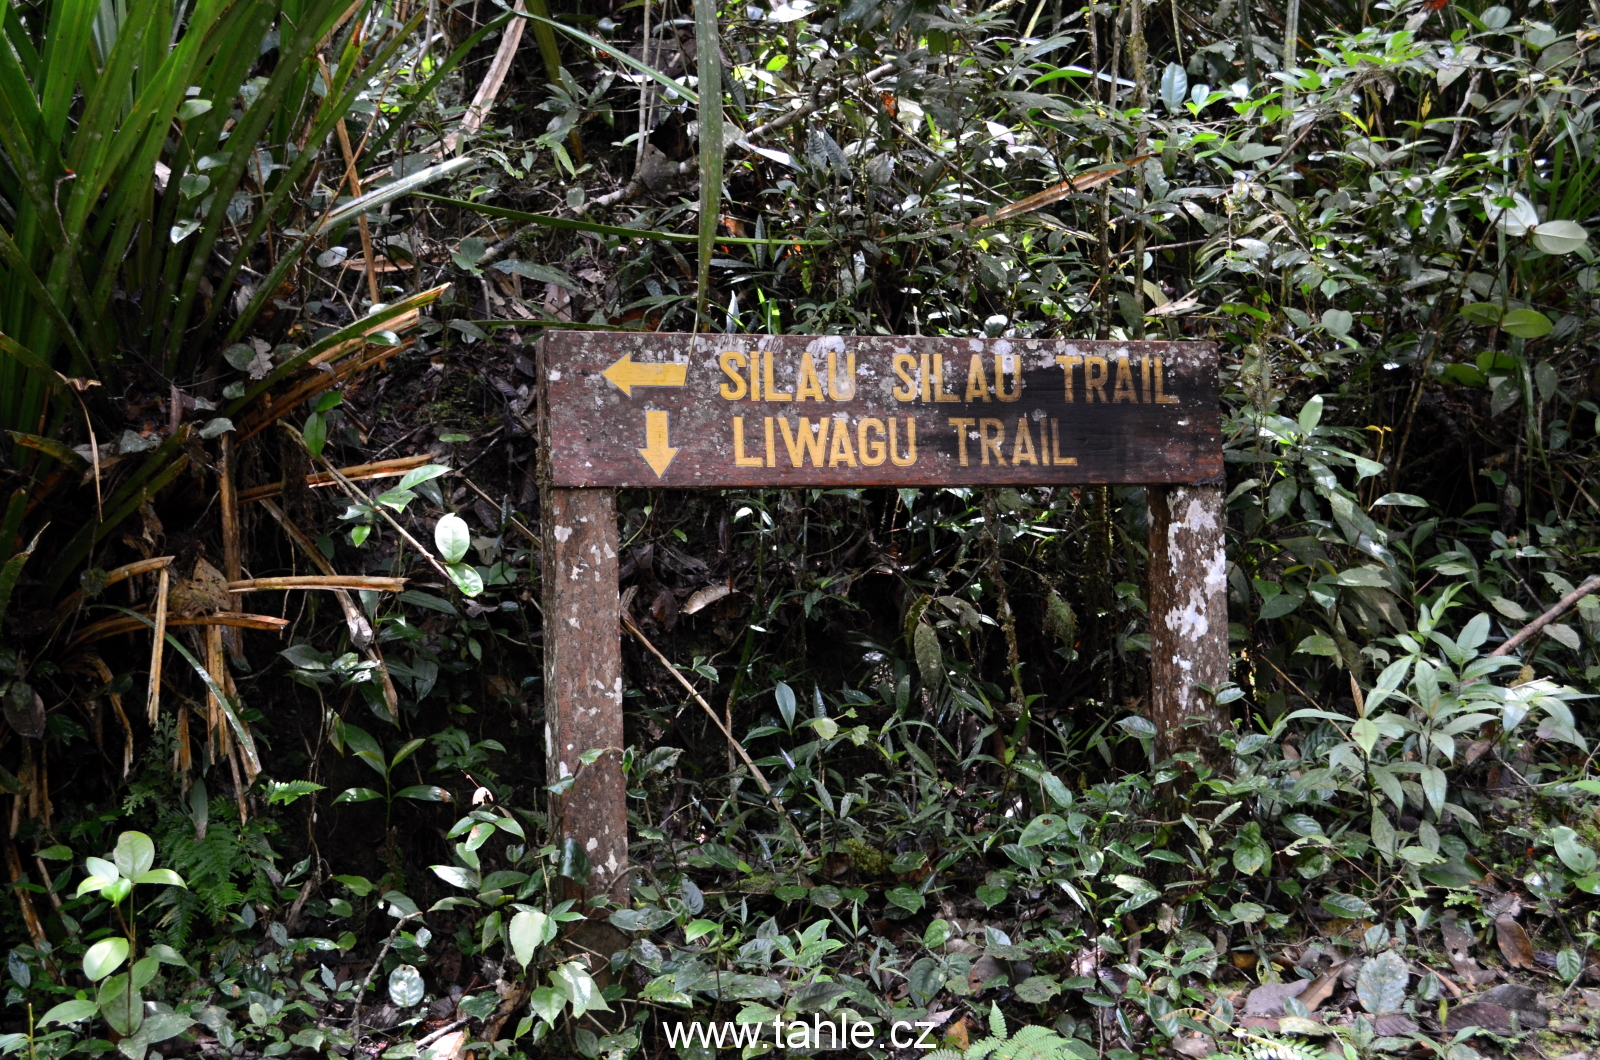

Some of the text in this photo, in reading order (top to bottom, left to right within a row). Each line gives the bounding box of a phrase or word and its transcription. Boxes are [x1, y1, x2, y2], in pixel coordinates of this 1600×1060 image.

[719, 351, 1180, 404] SILAU SILAU TRAIL
[733, 416, 1078, 468] LIWAGU TRAIL
